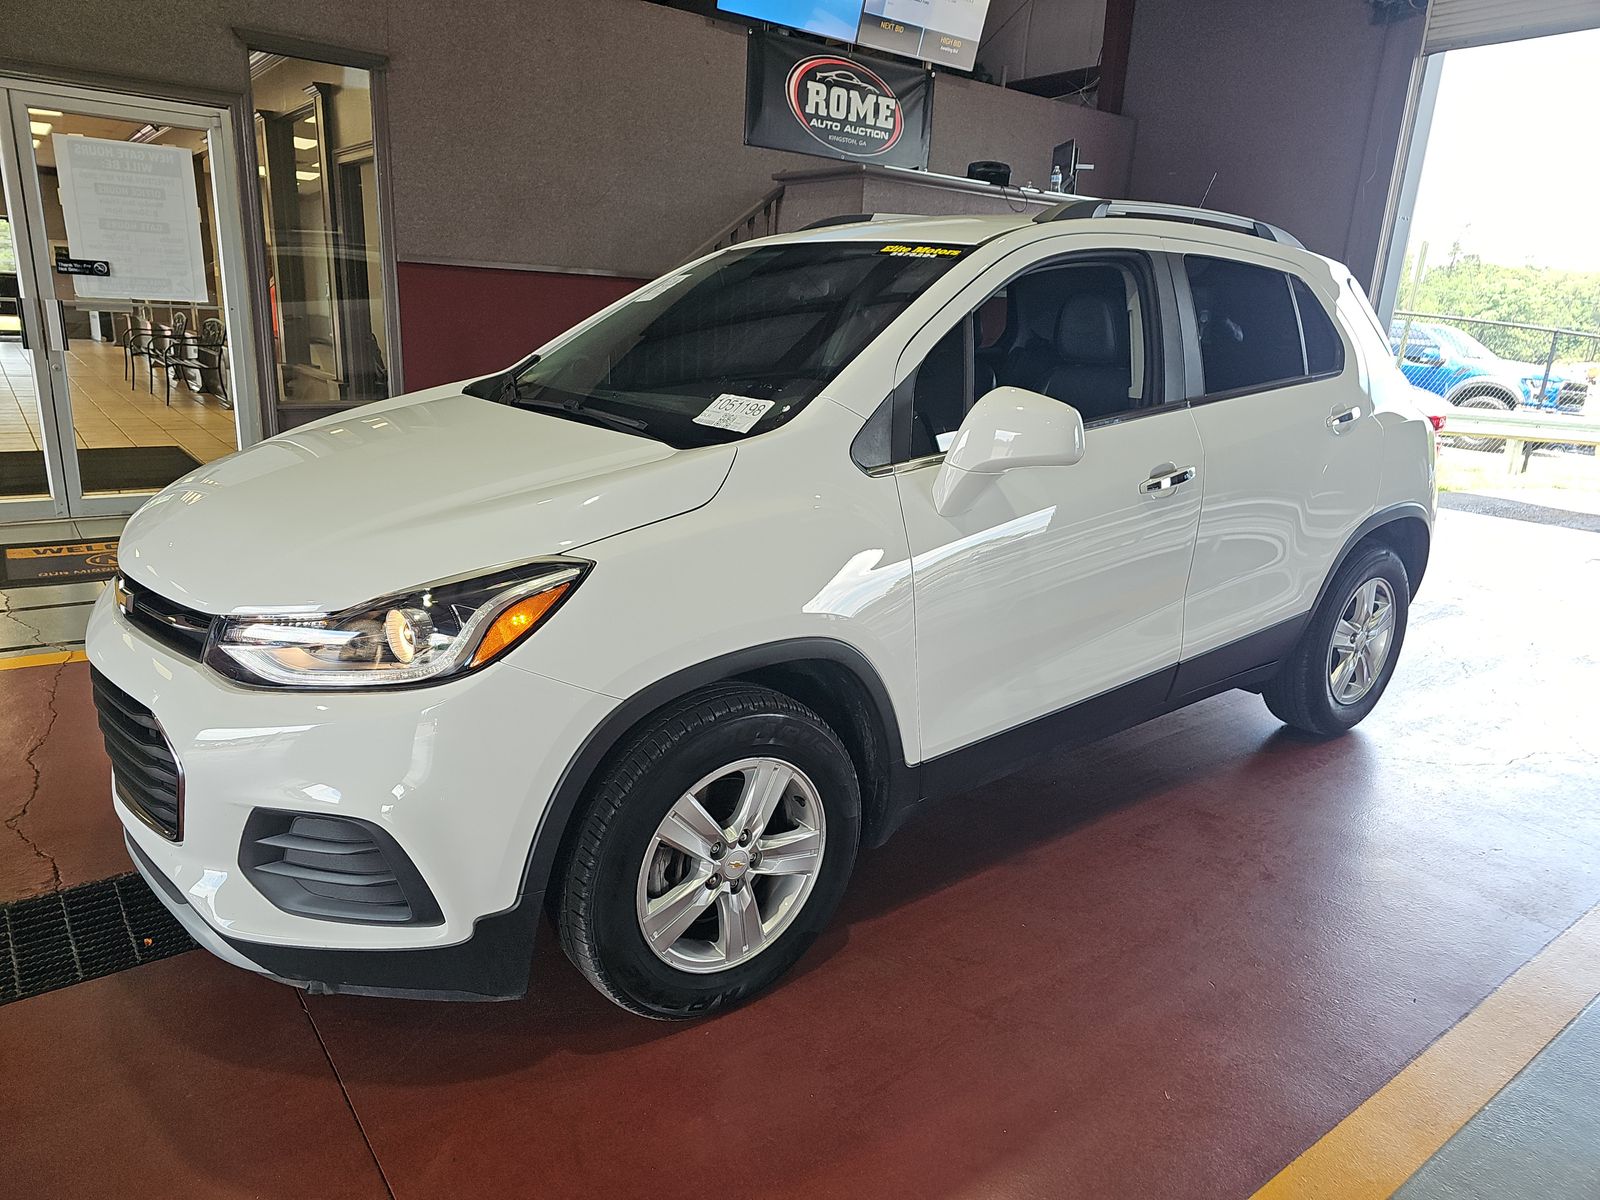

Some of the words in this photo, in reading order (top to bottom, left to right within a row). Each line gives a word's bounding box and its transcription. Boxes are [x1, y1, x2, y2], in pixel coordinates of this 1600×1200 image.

[880, 20, 895, 31] NEXT
[895, 24, 905, 33] BID
[940, 36, 953, 46] HIGH
[953, 39, 962, 48] BID
[805, 80, 896, 130] ROME
[809, 118, 841, 131] AUTO
[843, 124, 889, 140] AUCTION
[828, 134, 858, 146] KINGSTON,
[880, 245, 912, 253] Elite
[911, 246, 961, 256] Motors
[713, 398, 766, 417] 1051198
[32, 544, 118, 555] WELC
